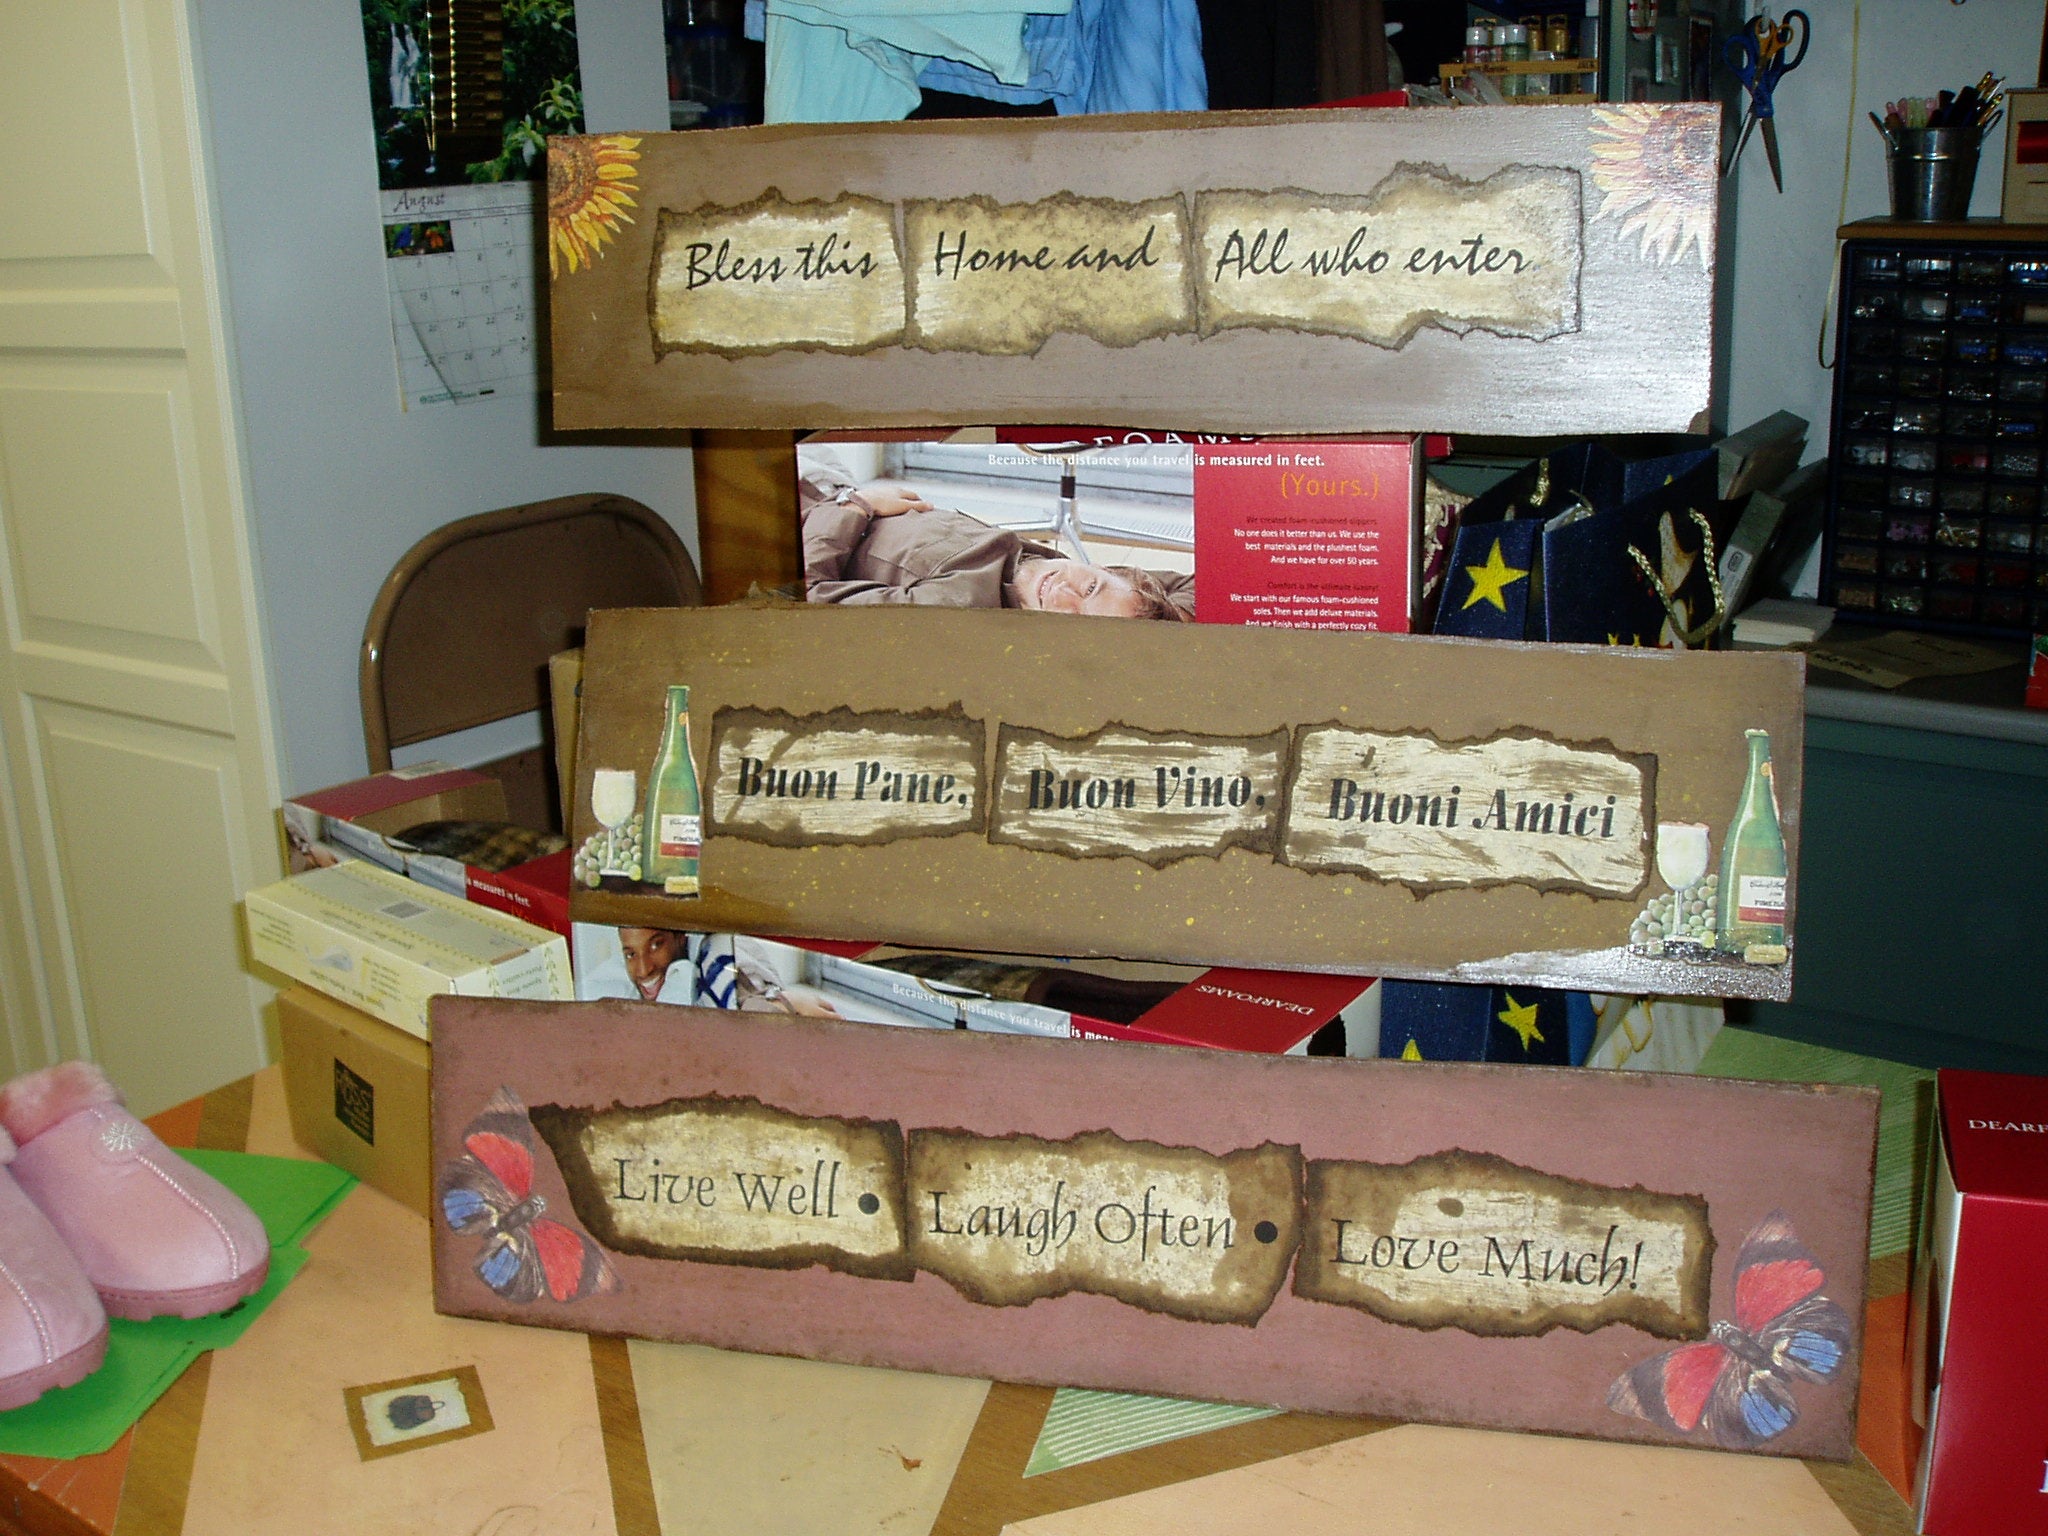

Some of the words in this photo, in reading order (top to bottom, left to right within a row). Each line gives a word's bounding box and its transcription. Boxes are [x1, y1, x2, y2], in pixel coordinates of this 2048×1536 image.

[685, 238, 788, 291] Bless
[793, 232, 879, 281] this
[934, 229, 1056, 281] Home
[1062, 224, 1159, 272] and
[1214, 227, 1294, 283] All
[1300, 225, 1390, 277] who
[1403, 232, 1534, 276] enter
[988, 453, 1038, 466] Because
[1042, 453, 1063, 465] the
[1067, 453, 1120, 466] distance
[1125, 455, 1148, 468] you
[1152, 453, 1189, 466] travel
[1194, 453, 1205, 466] is
[1210, 453, 1272, 466] measured
[1277, 454, 1290, 466] in
[1294, 454, 1325, 466] feet.
[1281, 471, 1380, 499] (Yours.)
[1234, 529, 1245, 538] No
[1246, 529, 1259, 538] one
[1261, 529, 1278, 538] does
[1280, 529, 1284, 538] it
[1286, 529, 1308, 538] better
[1309, 530, 1326, 538] than
[1328, 530, 1336, 538] us.
[1339, 530, 1351, 538] We
[1353, 530, 1366, 538] use
[1367, 530, 1379, 538] the
[1245, 542, 1260, 550] best
[1264, 543, 1296, 551] materials
[1298, 543, 1312, 551] and
[1314, 543, 1325, 551] the
[1327, 543, 1356, 553] plushest
[1359, 543, 1378, 552] foam.
[1271, 555, 1286, 564] And
[1287, 555, 1298, 564] we
[1299, 555, 1316, 564] have
[1317, 555, 1328, 564] for
[1330, 557, 1346, 565] over
[1347, 557, 1357, 565] 50
[1358, 558, 1378, 566] years.
[1230, 593, 1242, 602] We
[1243, 593, 1260, 602] start
[1261, 593, 1277, 602] with
[1279, 594, 1291, 603] our
[1293, 594, 1320, 603] famous
[1321, 594, 1378, 604] foam-cushioned
[1253, 607, 1272, 616] soles.
[1274, 607, 1292, 616] Then
[1293, 608, 1304, 616] we
[1305, 608, 1318, 616] add
[1320, 608, 1342, 617] deluxe
[1344, 608, 1378, 617] materials.
[735, 756, 838, 800] Buon
[852, 760, 968, 810] Pane,
[1027, 769, 1138, 810] Buon
[1154, 765, 1266, 812] Vino,
[1324, 778, 1462, 829] Buoni
[1472, 788, 1617, 838] Amici
[892, 983, 935, 1005] Because
[939, 994, 958, 1009] the
[959, 999, 1006, 1020] distance
[1009, 1013, 1030, 1027] you
[1034, 1017, 1068, 1035] travel
[1071, 1024, 1081, 1038] is
[1196, 984, 1316, 1016] DEARFOAMS
[612, 1158, 716, 1207] Live
[733, 1159, 841, 1219] Well
[927, 1180, 1077, 1257] Laugh
[1094, 1185, 1236, 1262] Often
[1329, 1218, 1460, 1274] Love
[1478, 1225, 1644, 1297] Much!
